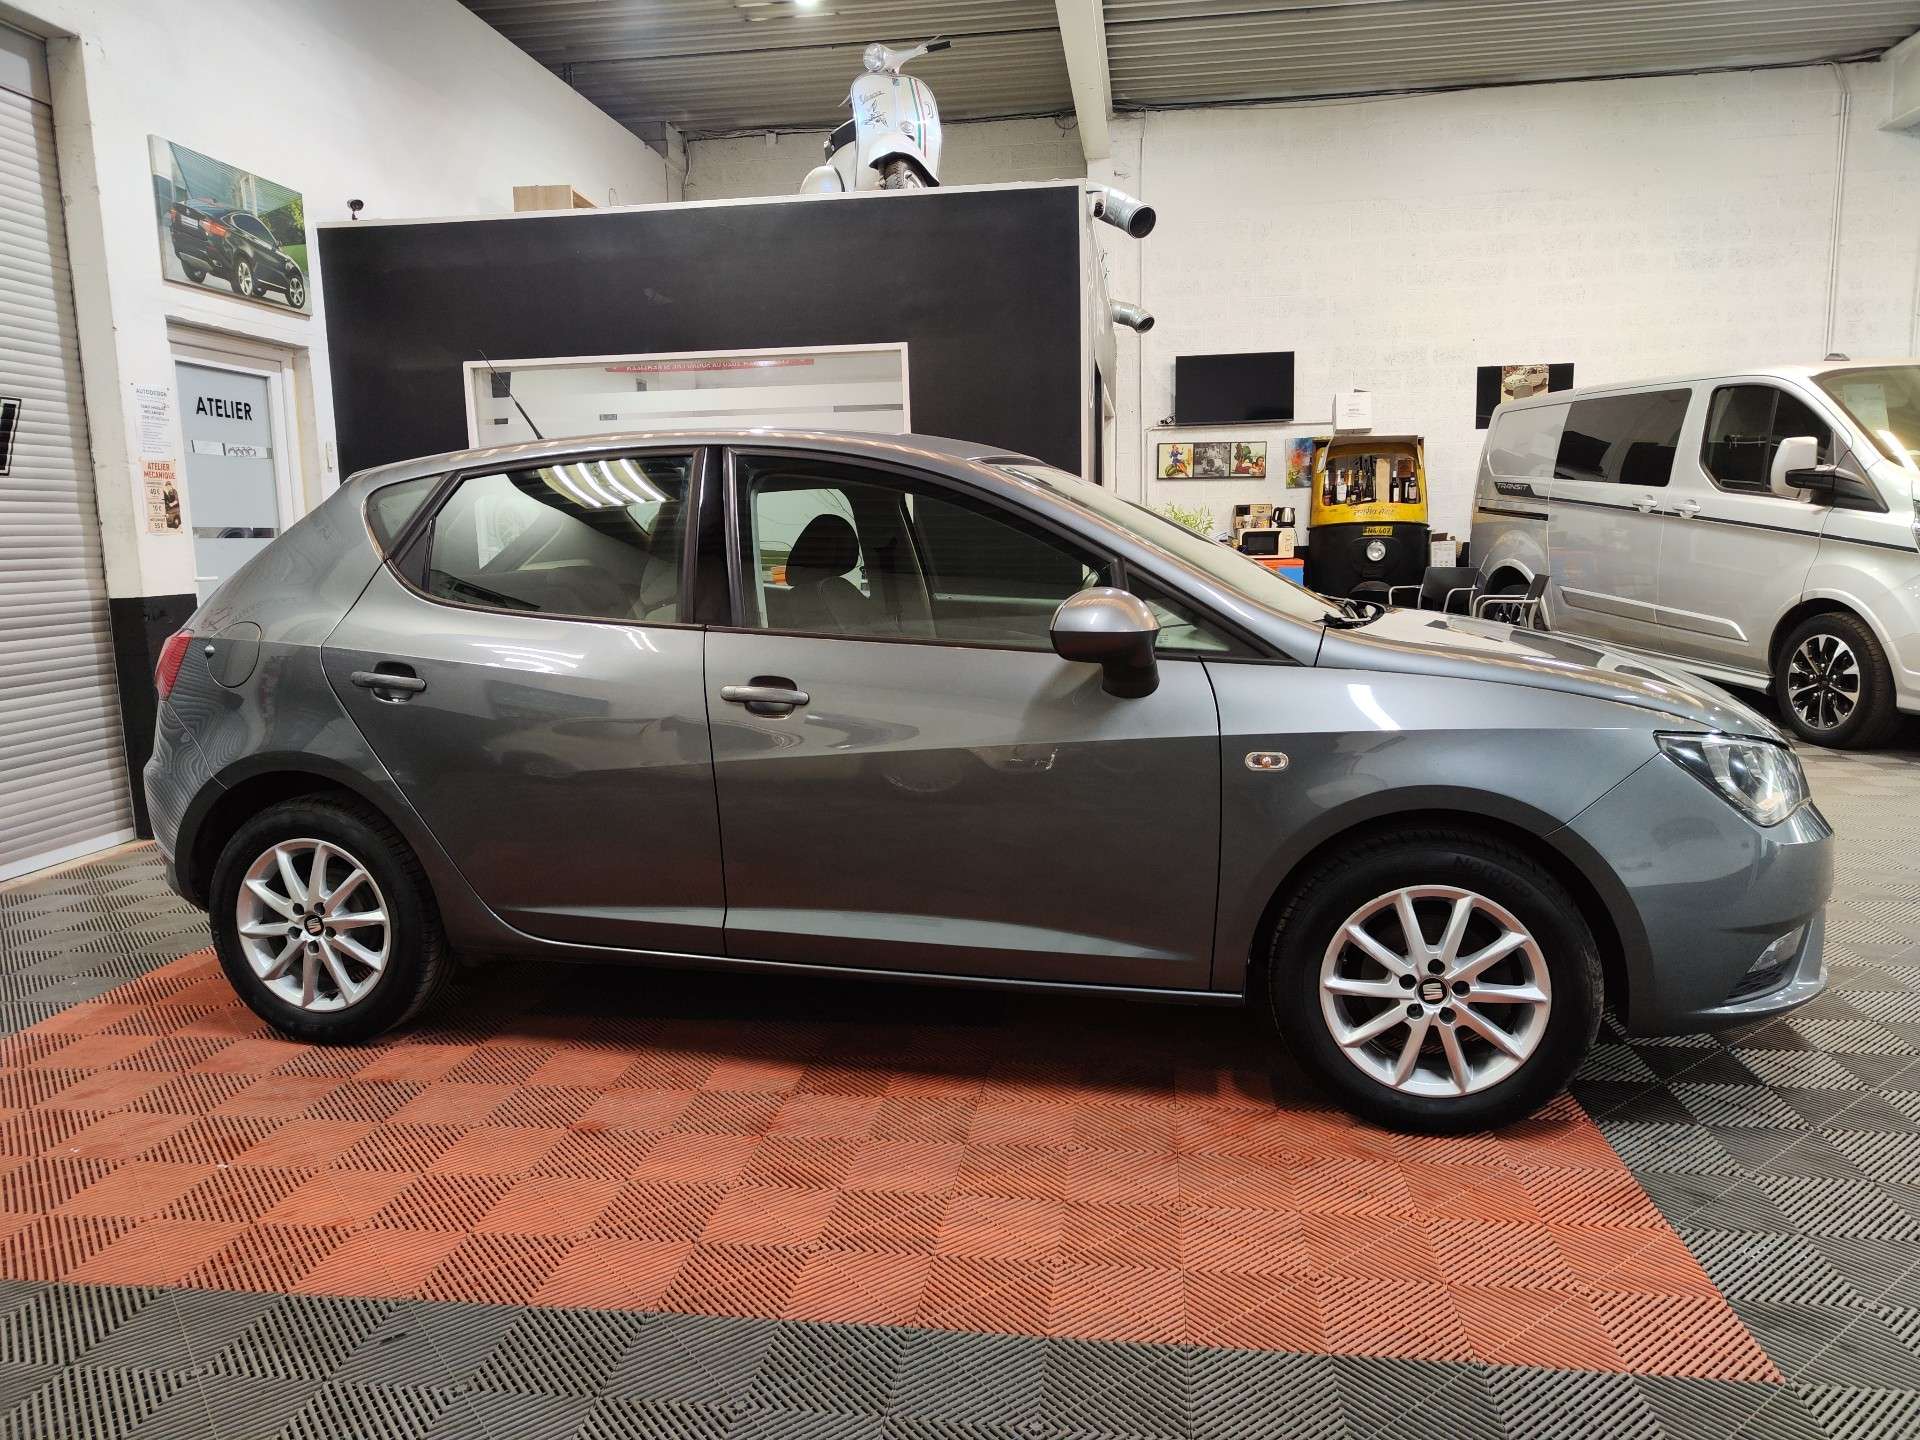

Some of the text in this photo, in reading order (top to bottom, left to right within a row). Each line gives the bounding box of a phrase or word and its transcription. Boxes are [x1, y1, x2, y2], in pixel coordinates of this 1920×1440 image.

[196, 396, 252, 421] ATELIER
[147, 462, 170, 471] ATELIER
[143, 470, 176, 480] MECANIQUE
[1496, 482, 1529, 491] TRANSIT
